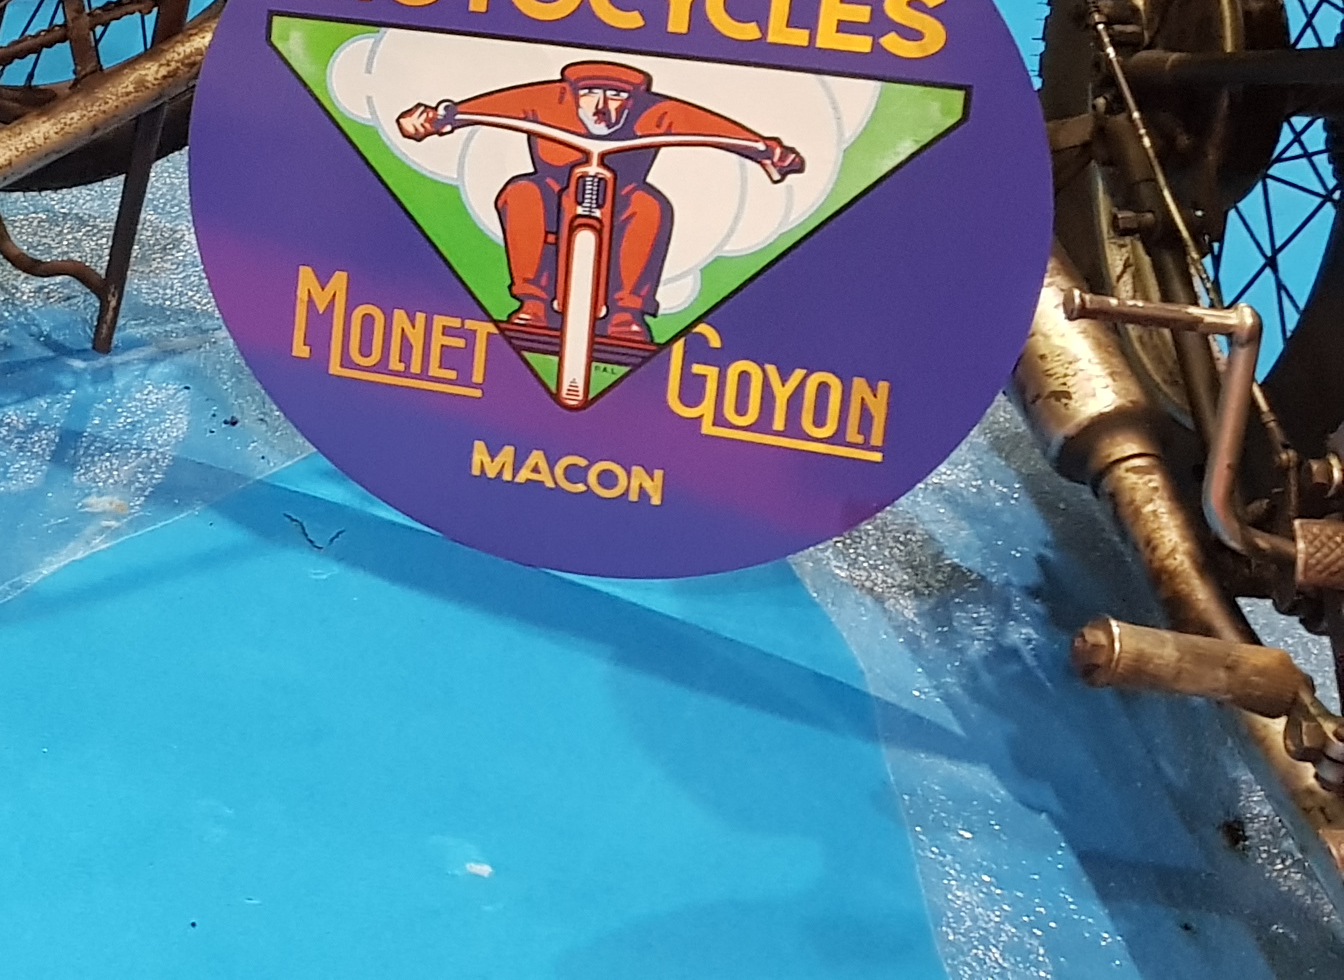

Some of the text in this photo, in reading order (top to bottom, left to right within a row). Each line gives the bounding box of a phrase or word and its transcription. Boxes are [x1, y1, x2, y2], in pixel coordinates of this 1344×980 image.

[291, 265, 891, 461] MONET GOYON
[471, 440, 664, 506] MACON
